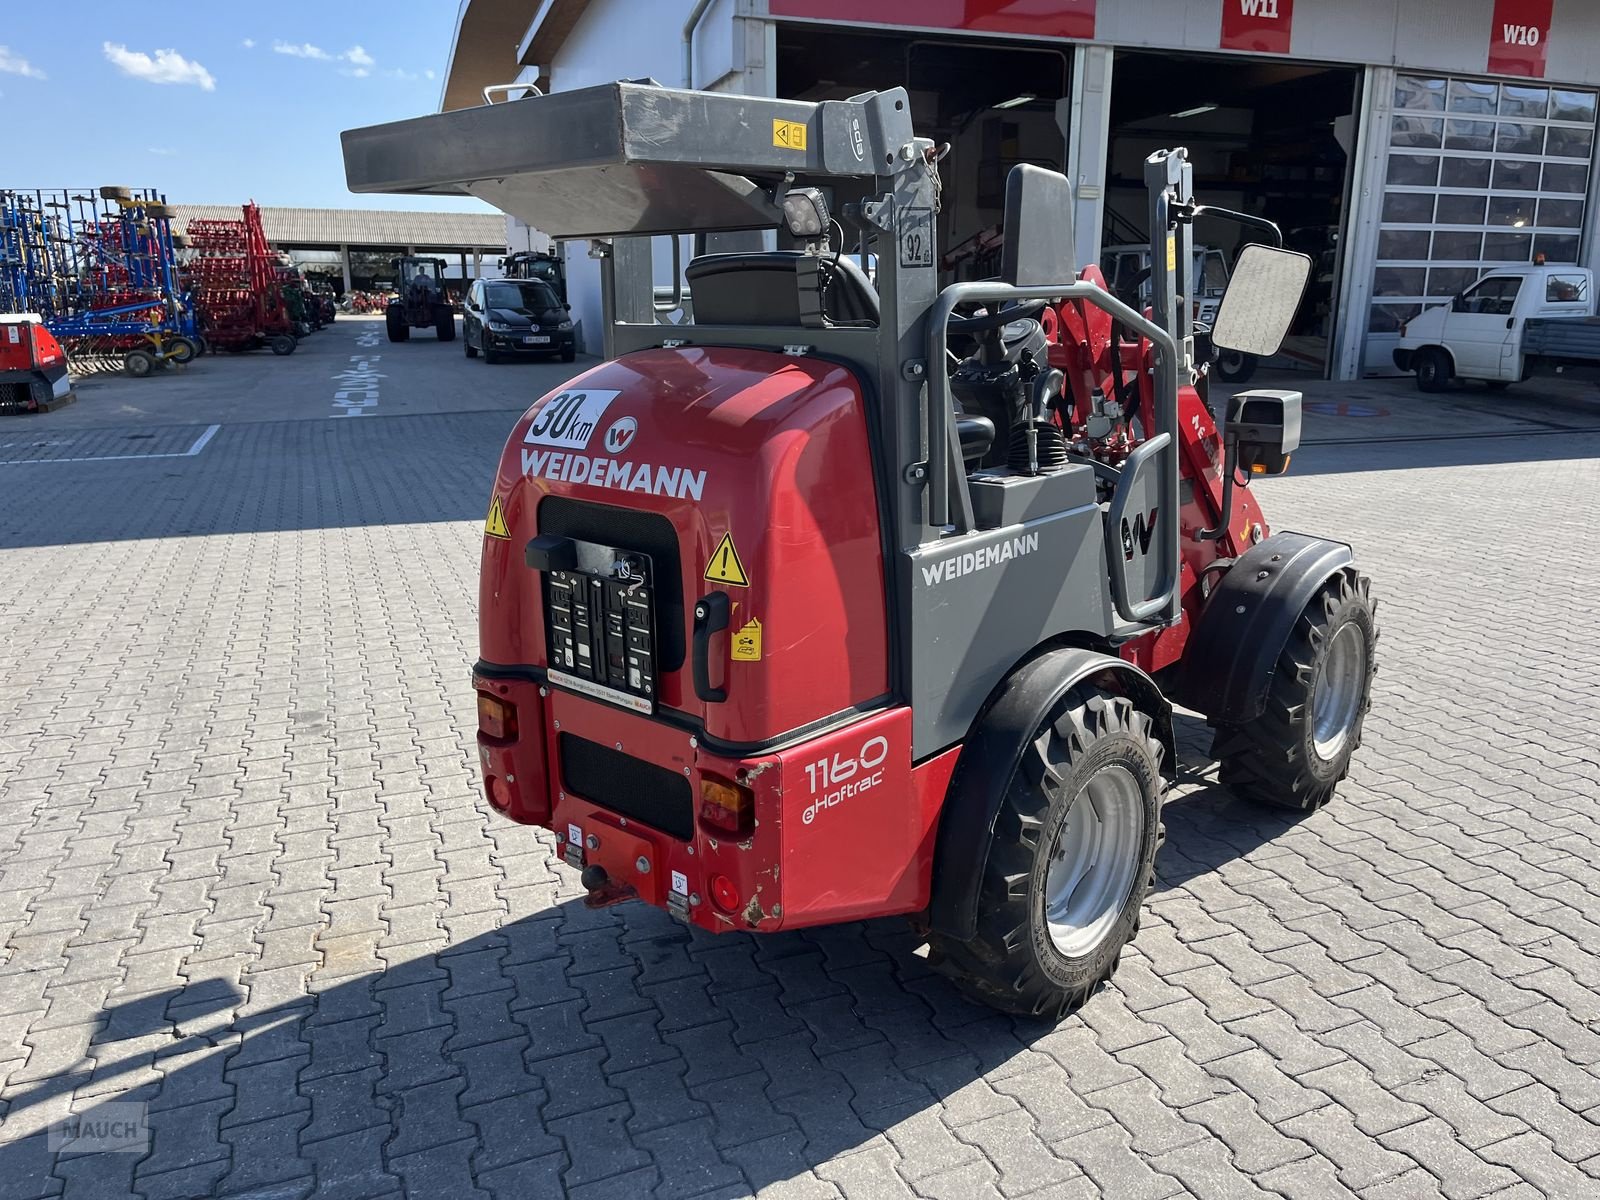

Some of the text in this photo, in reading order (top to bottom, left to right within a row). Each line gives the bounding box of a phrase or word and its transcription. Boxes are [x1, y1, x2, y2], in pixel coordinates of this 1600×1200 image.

[1240, 0, 1278, 18] W11
[1504, 24, 1539, 46] W10
[908, 234, 921, 261] 92
[521, 448, 707, 501] WEIDEMANN
[921, 532, 1039, 586] WEIDEMANN
[805, 736, 888, 794] 1160
